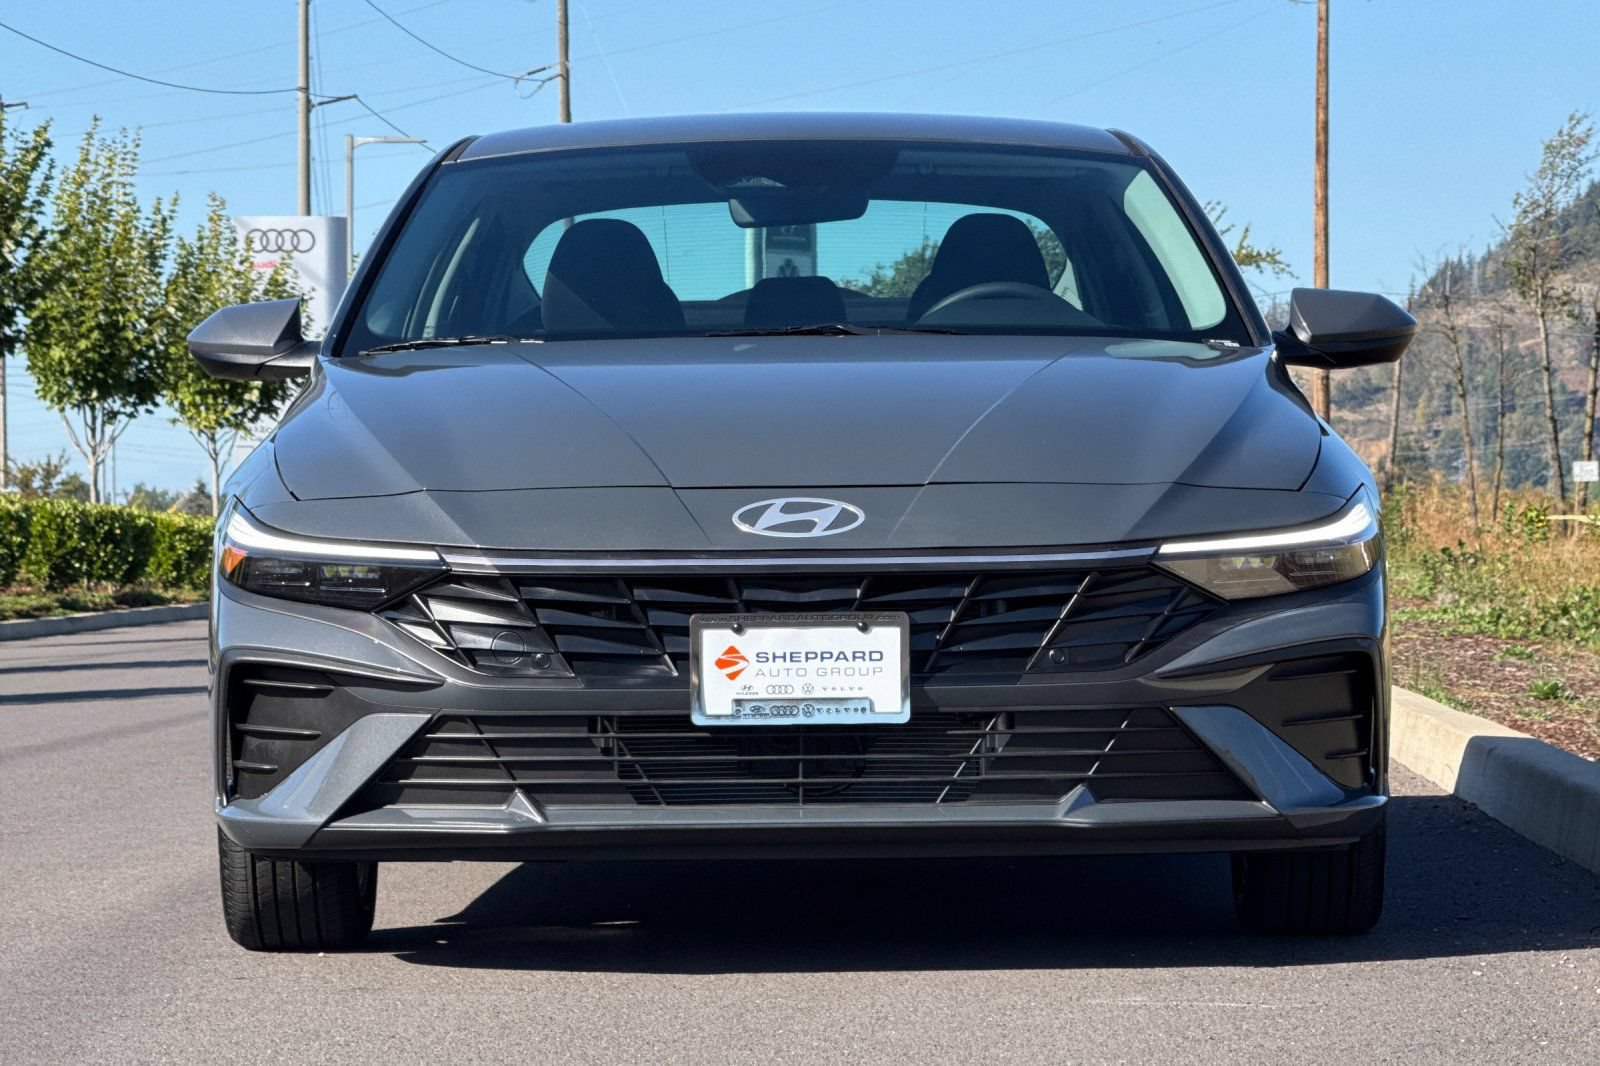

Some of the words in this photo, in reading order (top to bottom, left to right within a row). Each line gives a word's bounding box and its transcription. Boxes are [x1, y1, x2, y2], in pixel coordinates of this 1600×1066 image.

[755, 650, 884, 663] SHEPPARD
[754, 667, 808, 678] AUTO
[816, 666, 884, 677] GROUP
[816, 706, 860, 715] VOLVO
